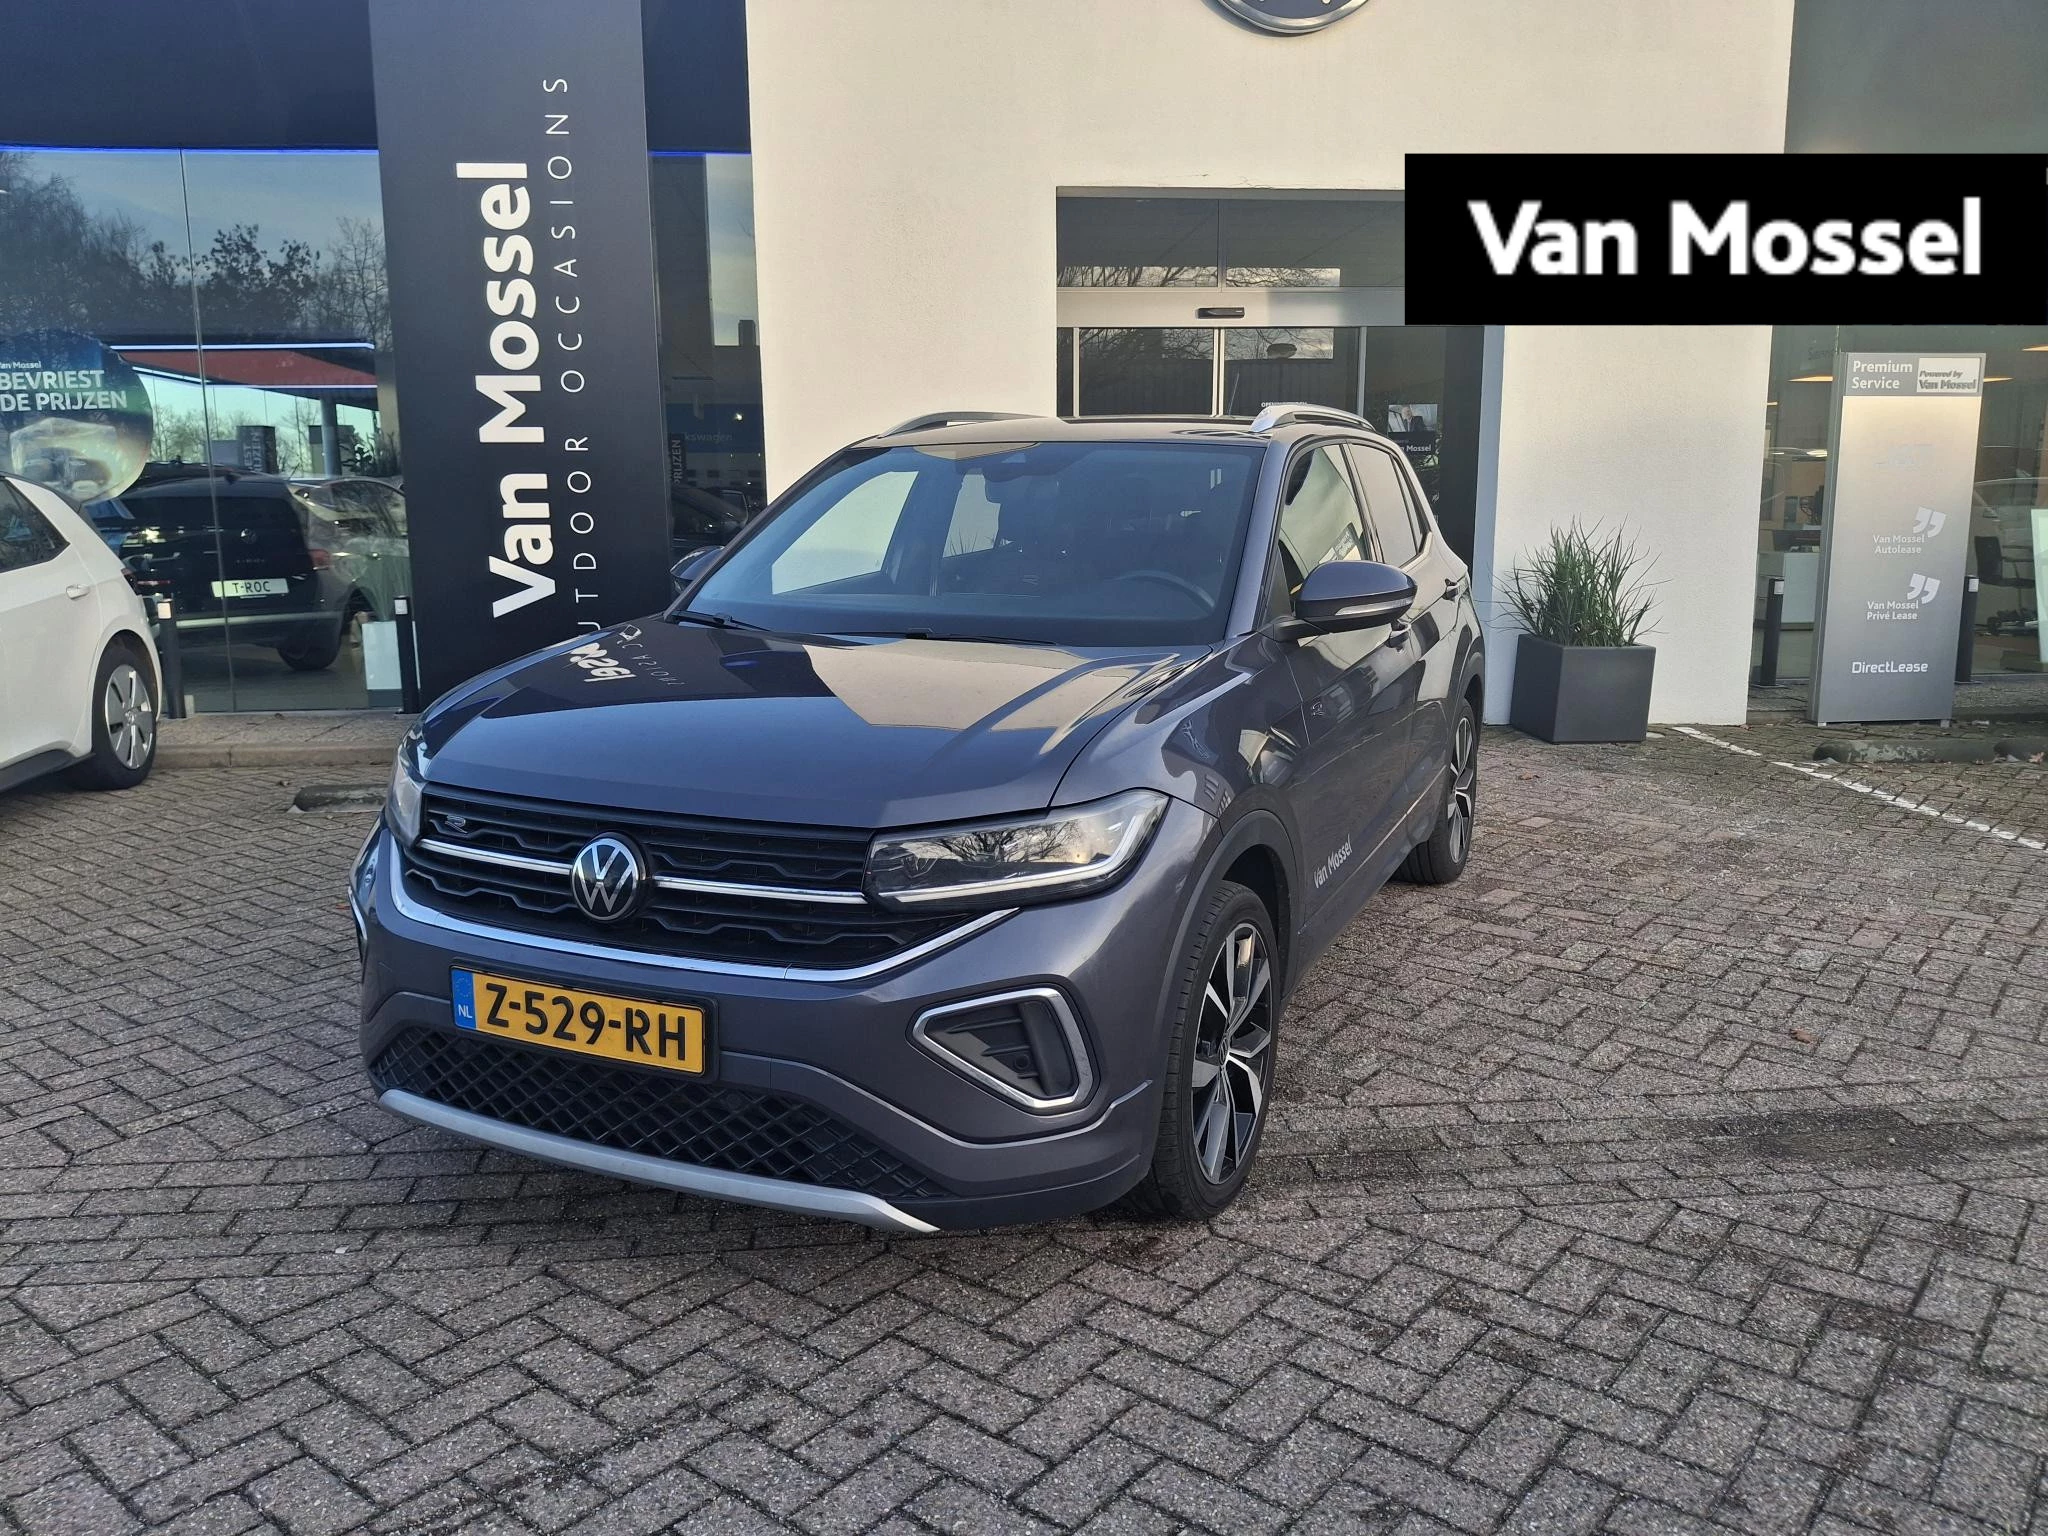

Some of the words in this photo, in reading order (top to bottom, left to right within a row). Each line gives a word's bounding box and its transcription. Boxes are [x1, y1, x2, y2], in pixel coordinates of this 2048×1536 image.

[542, 78, 586, 393] OCCASIONS
[456, 162, 545, 443] Mossel
[13, 360, 42, 369] Mossel
[1852, 359, 1914, 374] Premium
[0, 369, 105, 391] BEVRIEST
[1851, 376, 1901, 390] Service
[0, 393, 32, 412] DE
[35, 390, 129, 411] PRIJZEN
[1406, 443, 1432, 452] Mossel
[488, 473, 556, 618] Van
[1872, 534, 1891, 544] Van
[1892, 534, 1926, 544] Mossel
[1874, 545, 1922, 555] Autolease
[232, 581, 271, 594] T-ROC
[1867, 600, 1885, 610] Van
[1886, 599, 1919, 610] Mossel
[1866, 610, 1890, 620] Privé
[1892, 611, 1918, 620] Lease
[1851, 660, 1929, 674] DirectLease
[1313, 866, 1329, 889] Van
[1327, 833, 1353, 875] Mossel
[457, 1003, 473, 1019] NL
[485, 982, 686, 1061] Z-529-RH
